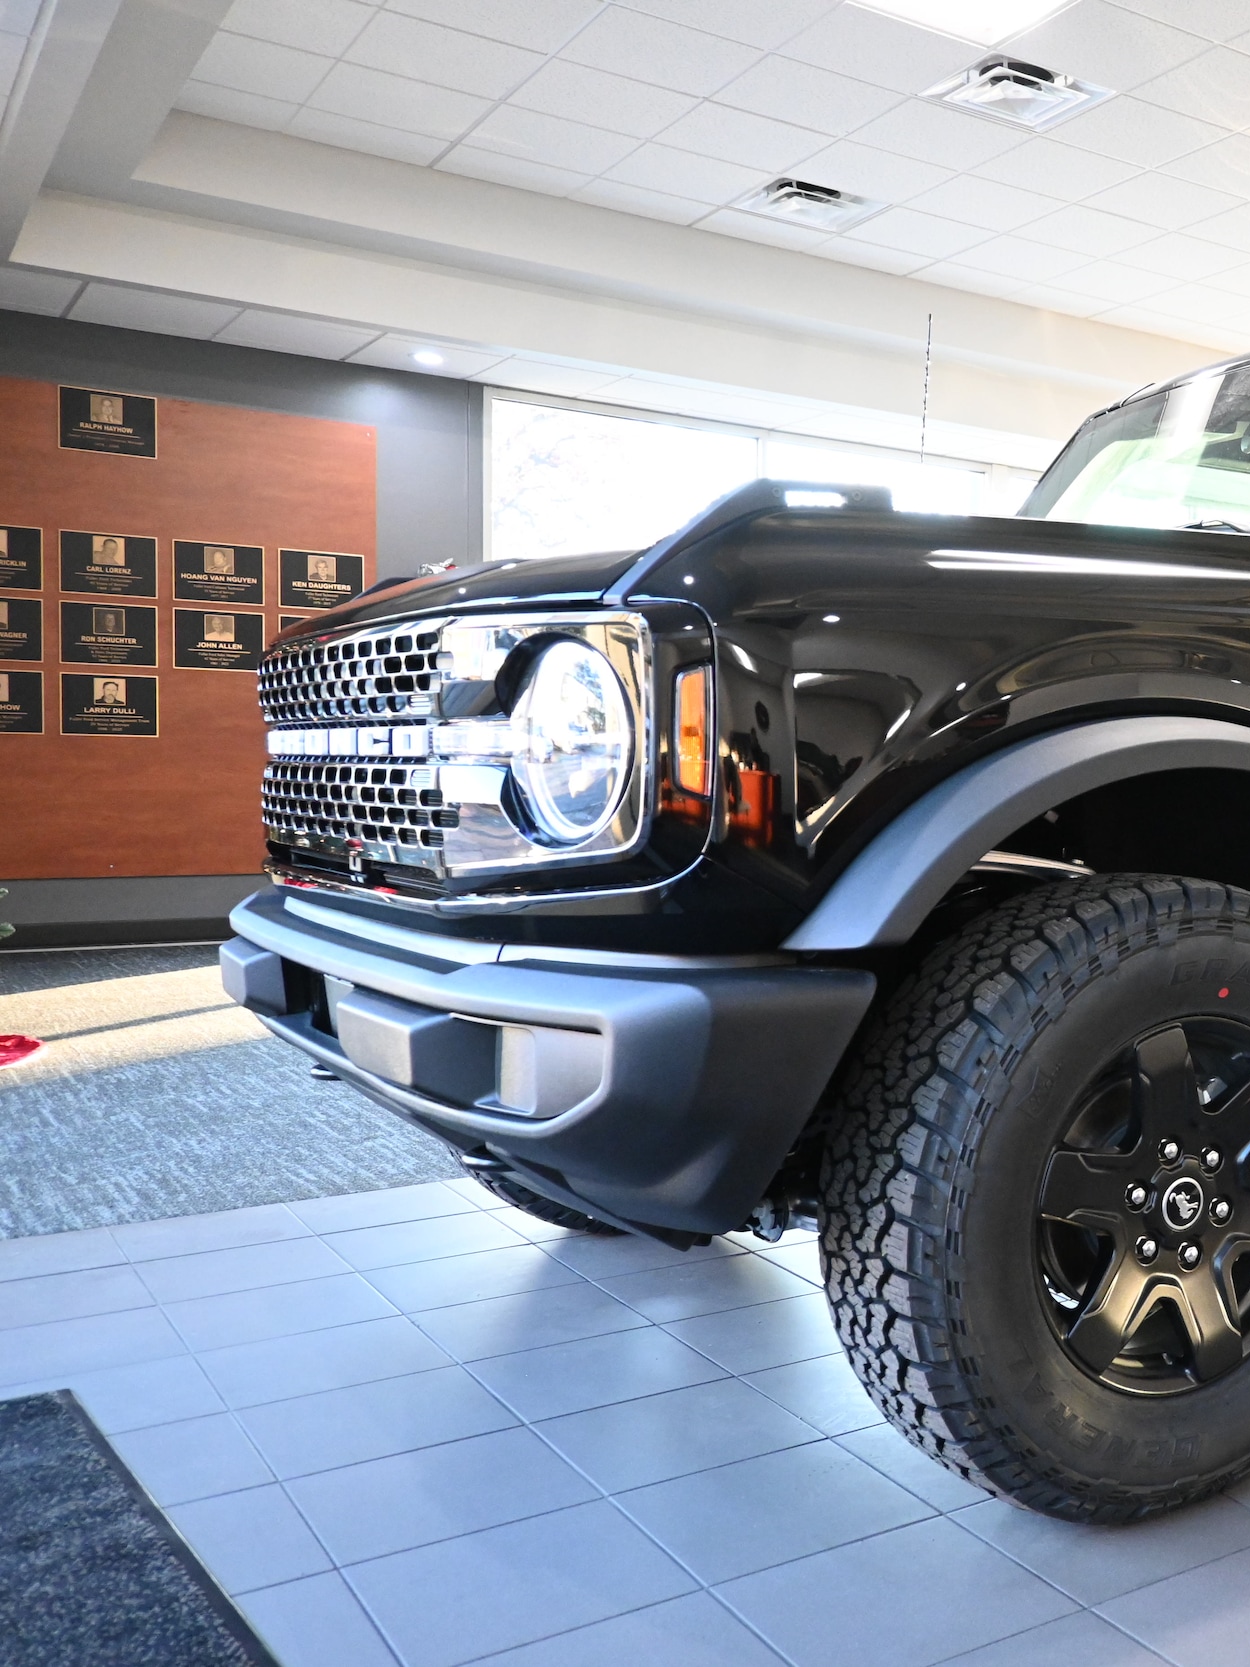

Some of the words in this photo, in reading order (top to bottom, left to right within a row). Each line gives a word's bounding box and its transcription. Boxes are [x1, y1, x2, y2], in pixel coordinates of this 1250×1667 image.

[80, 422, 102, 430] RALPH
[104, 425, 134, 434] HAYHOW
[86, 565, 104, 573] CARL
[105, 567, 132, 575] LORENZ
[226, 576, 257, 584] NGUYEN
[308, 582, 352, 591] DAUGHTERS
[81, 635, 96, 643] RON
[97, 636, 137, 644] SCHUCHTER
